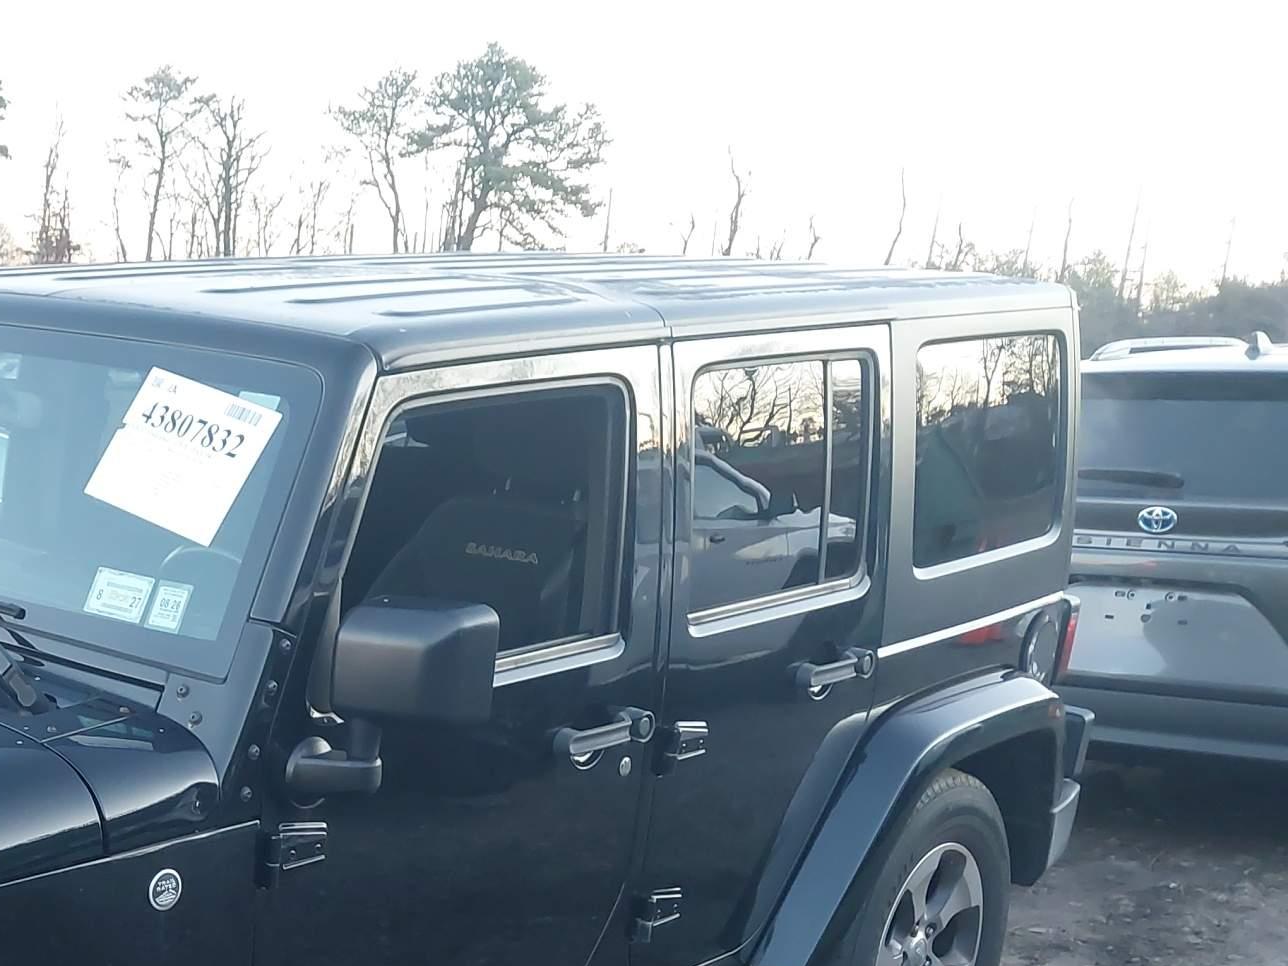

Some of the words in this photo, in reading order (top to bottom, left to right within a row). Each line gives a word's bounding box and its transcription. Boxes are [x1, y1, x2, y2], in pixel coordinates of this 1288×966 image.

[142, 402, 245, 458] 43807832
[465, 542, 539, 564] SAHARA
[1076, 536, 1241, 552] SIENNA
